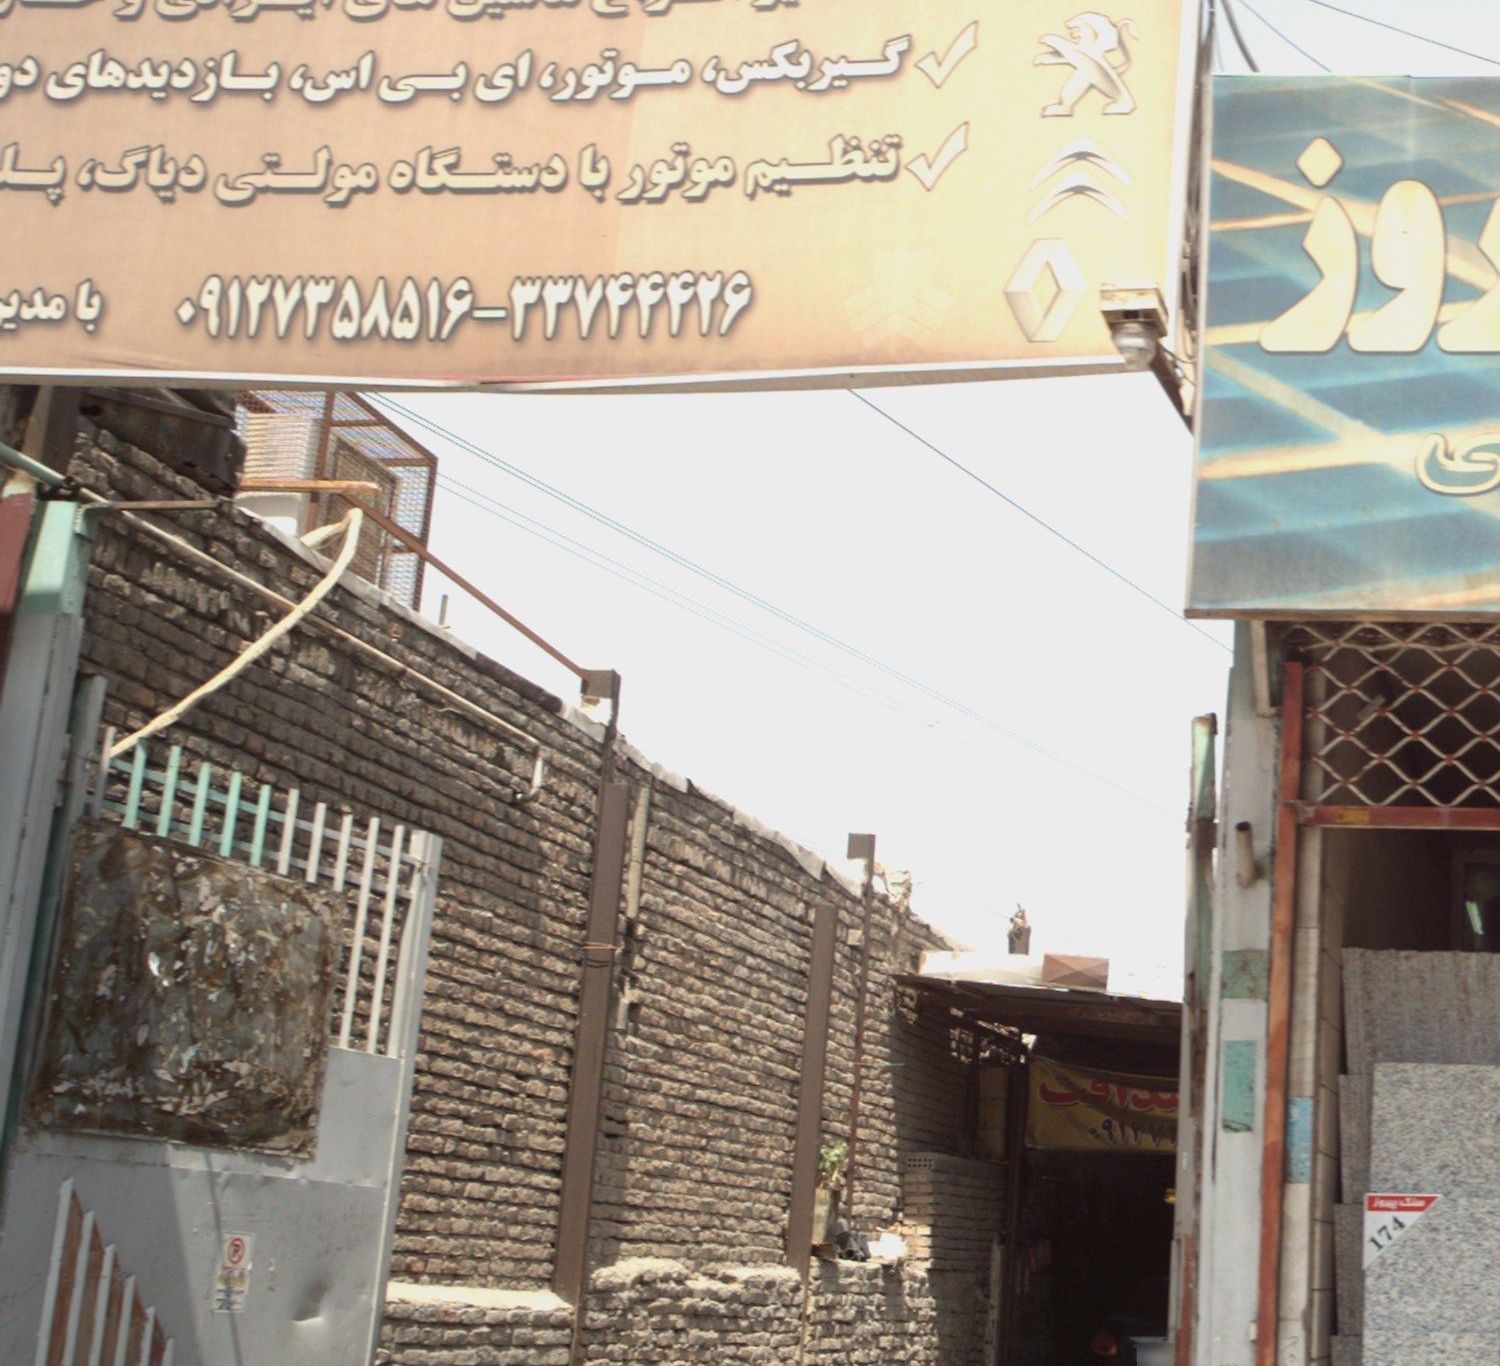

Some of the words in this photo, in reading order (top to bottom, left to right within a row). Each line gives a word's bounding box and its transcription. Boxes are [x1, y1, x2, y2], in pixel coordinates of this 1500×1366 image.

[45, 48, 281, 103] بازدیدهای
[378, 61, 467, 103] بی
[475, 48, 532, 102] ای
[214, 146, 380, 208] مولتی
[388, 146, 567, 196] دستگاه
[577, 143, 612, 205] با
[616, 142, 736, 205] موتور
[745, 133, 903, 197] تنظیم
[0, 286, 67, 331] مدی
[75, 278, 104, 334] با
[1368, 1215, 1405, 1250] 174
